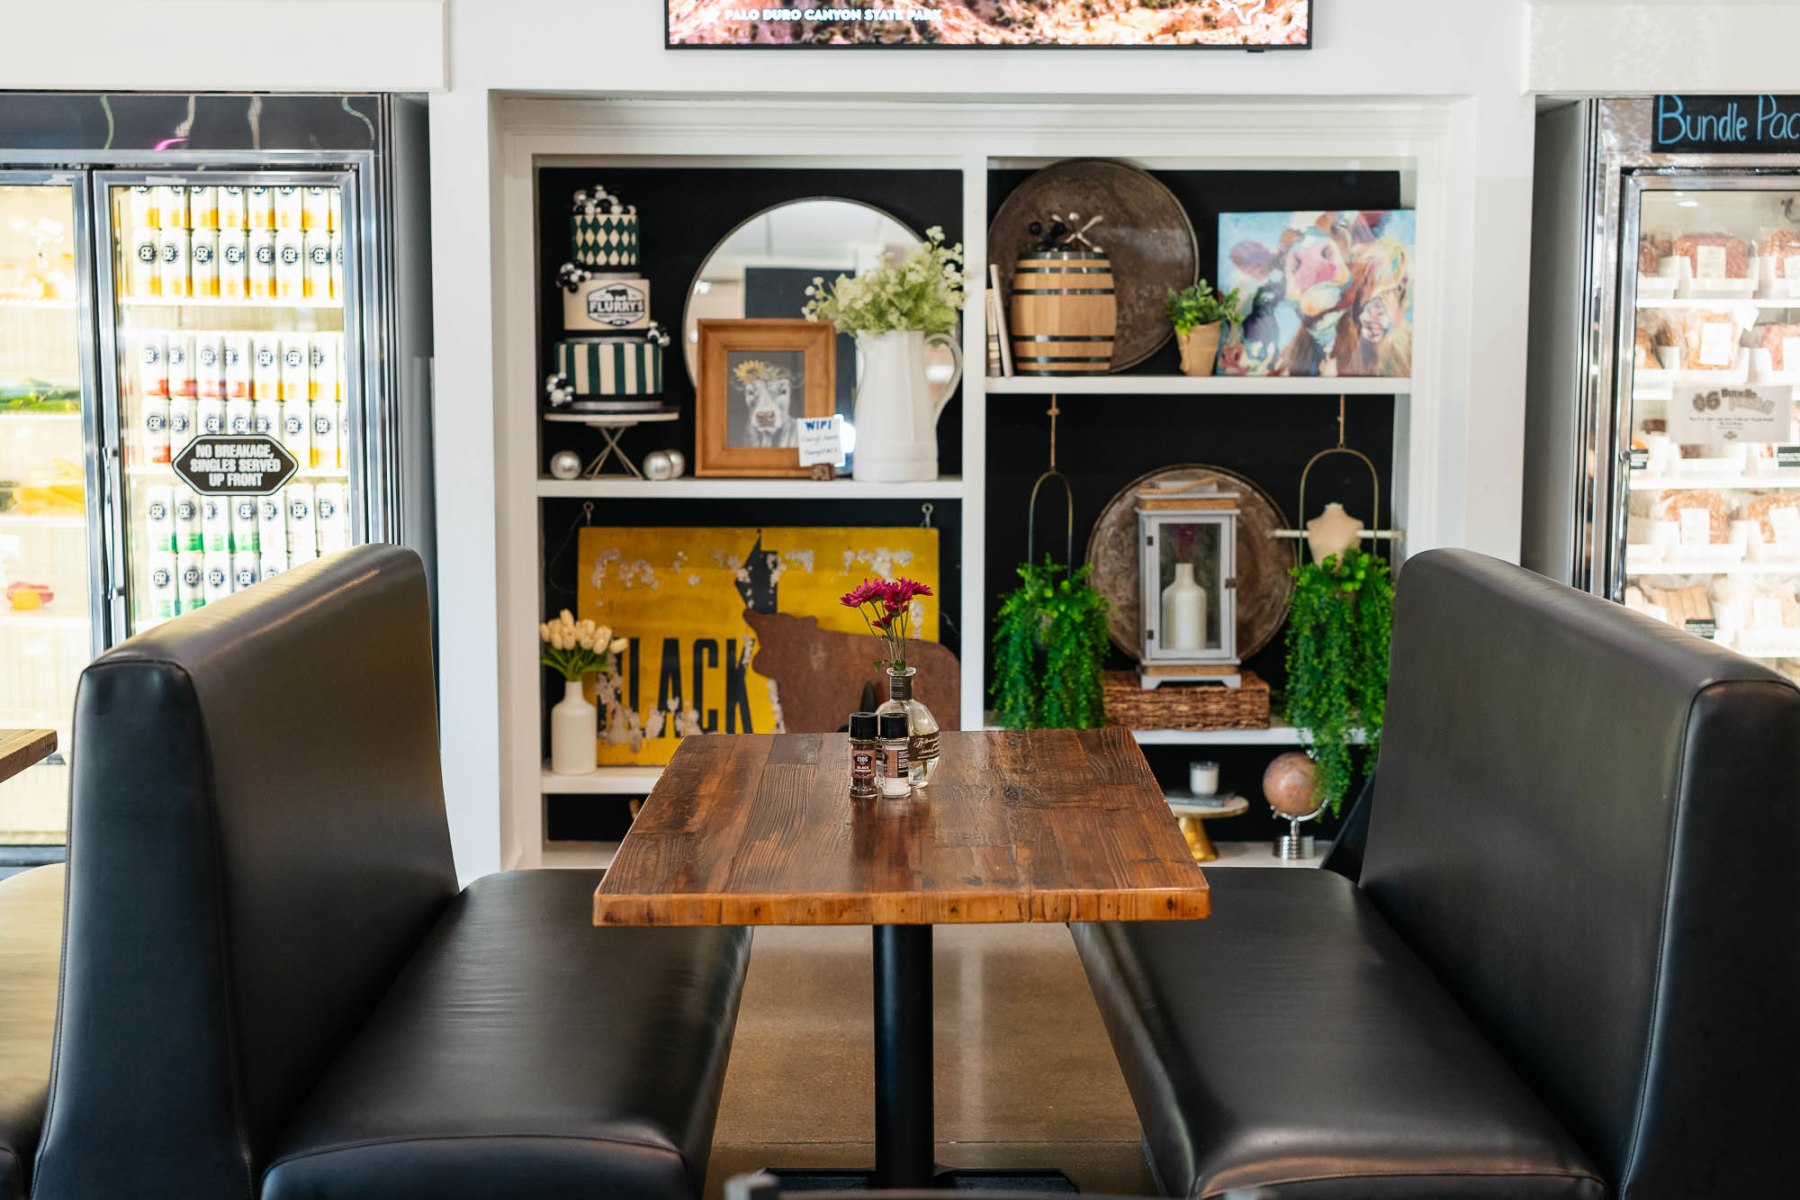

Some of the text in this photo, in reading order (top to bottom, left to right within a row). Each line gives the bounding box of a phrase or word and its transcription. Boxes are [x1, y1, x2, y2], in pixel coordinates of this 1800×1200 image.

[724, 9, 942, 21] PALO DURO CANYON STATE PARK
[1658, 95, 1748, 144] Bundle
[195, 444, 275, 459] NO BREAKAGE,
[190, 458, 281, 472] SINGLES SERVED
[208, 473, 263, 487] UP FRONT
